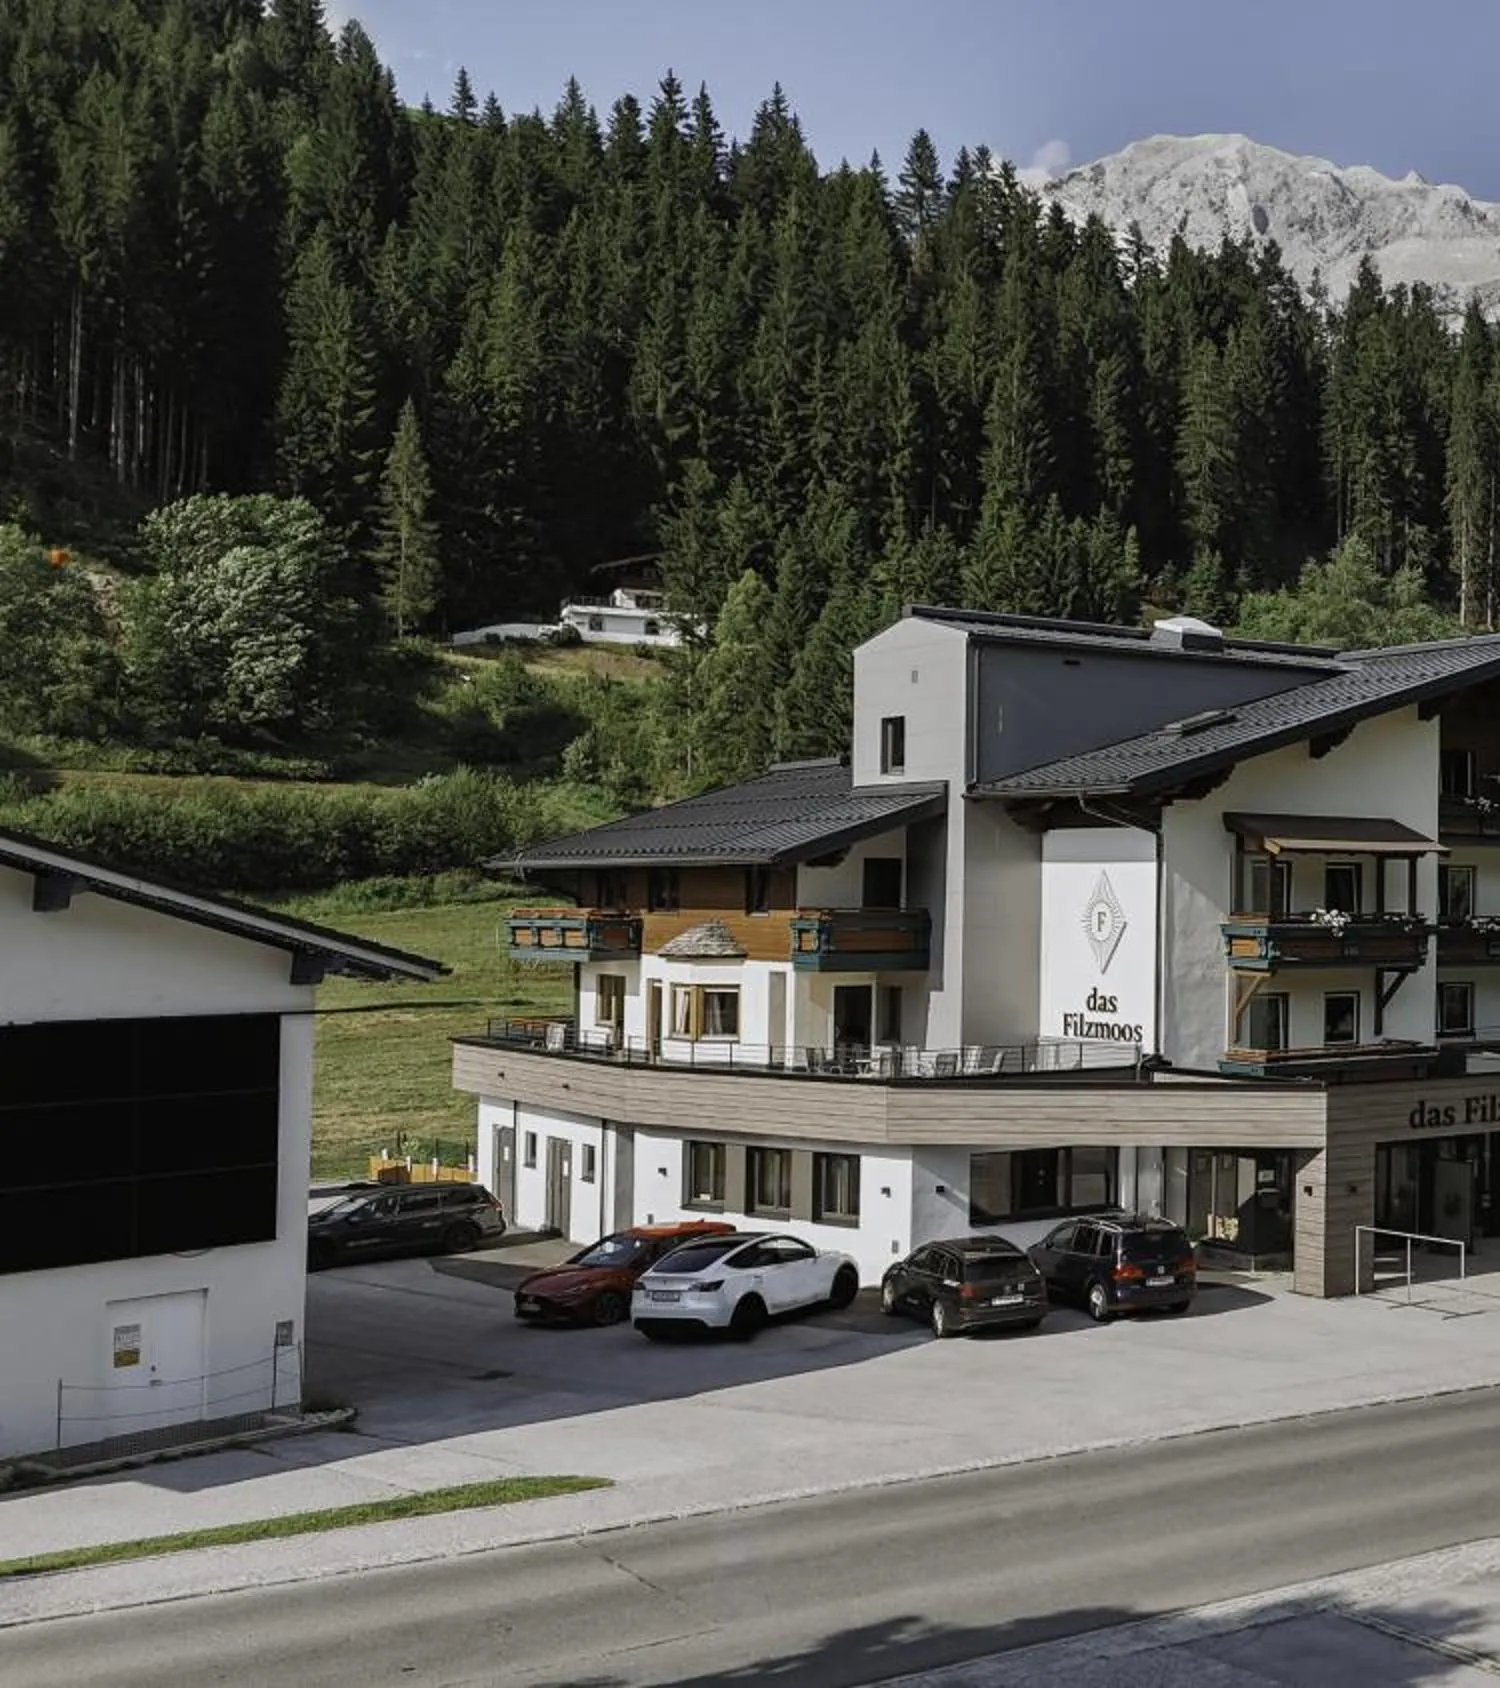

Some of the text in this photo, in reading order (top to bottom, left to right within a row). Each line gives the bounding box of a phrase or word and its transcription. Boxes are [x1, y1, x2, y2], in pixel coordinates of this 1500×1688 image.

[1097, 911, 1107, 932] F
[1087, 986, 1118, 1012] das
[1063, 1013, 1143, 1042] Filzmoos
[1409, 1100, 1456, 1129] das
